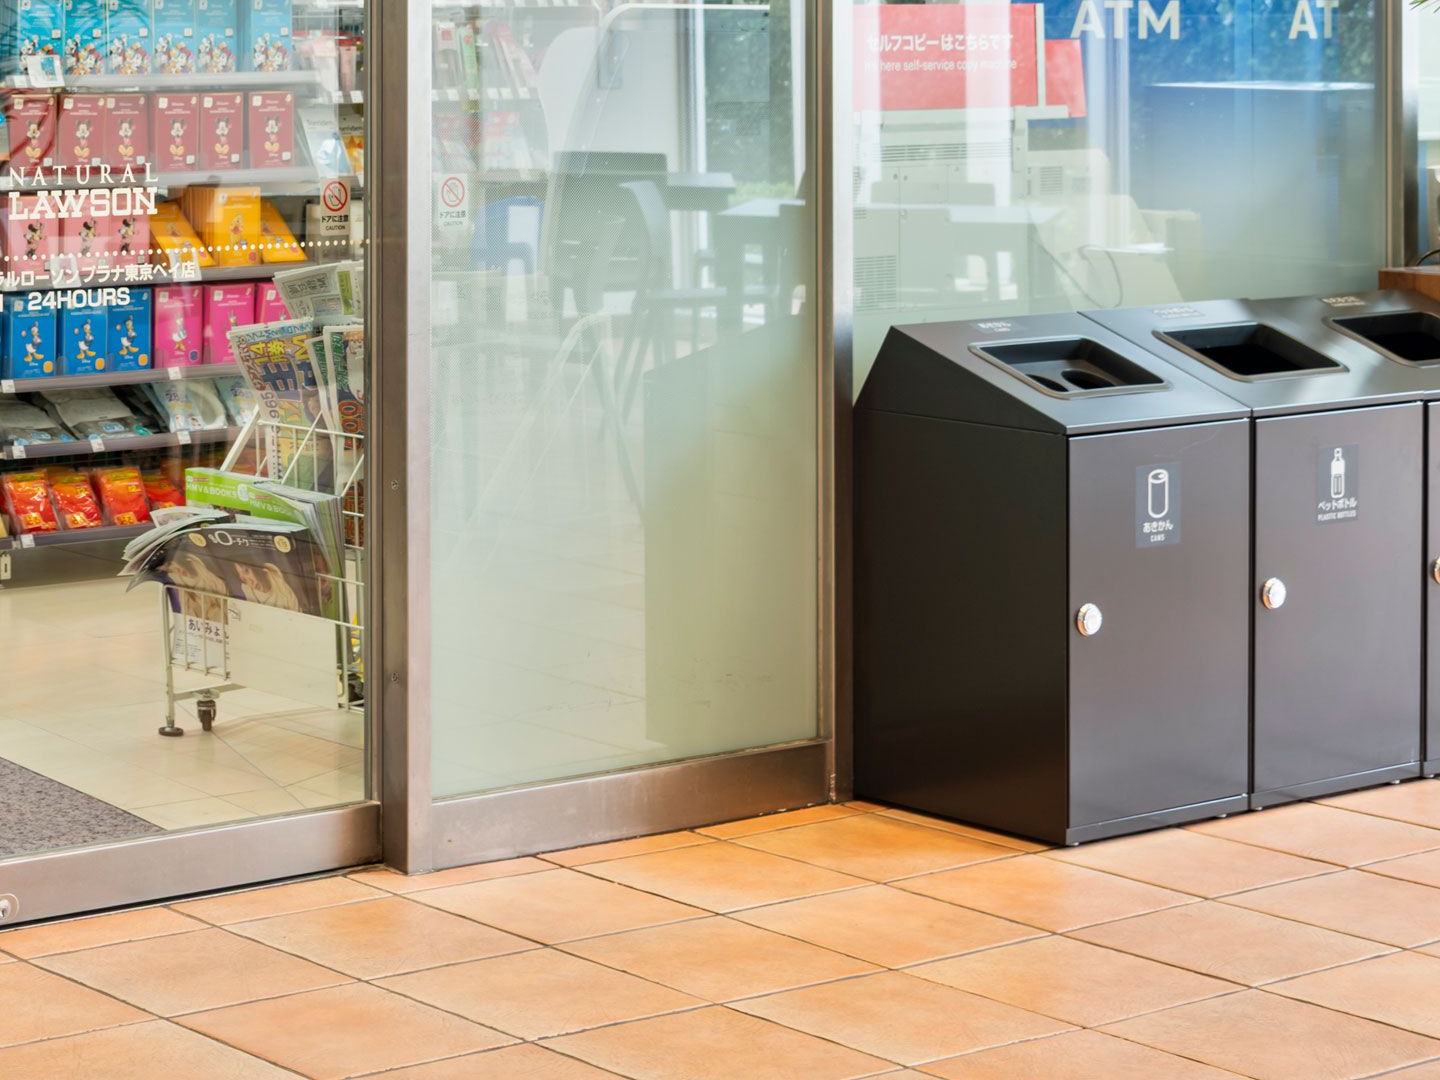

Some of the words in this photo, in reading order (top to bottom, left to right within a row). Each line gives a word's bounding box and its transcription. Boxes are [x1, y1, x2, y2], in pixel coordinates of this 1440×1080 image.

[1070, 0, 1180, 39] ATM
[1288, 0, 1339, 39] AT
[866, 33, 1013, 52] セルフコピーはこちらです
[880, 61, 901, 71] here
[904, 60, 955, 71] self-service
[9, 162, 159, 186] NATURAL
[9, 187, 158, 221] LAWSON
[321, 214, 349, 223] ドアに注意
[440, 209, 466, 219] ドアに注意
[83, 262, 195, 283] プラナ東京ベイ店
[27, 287, 130, 311] 24HOURS
[1317, 497, 1358, 510] ペットボトル
[1142, 520, 1173, 533] あきかん
[1150, 534, 1165, 542] CANS
